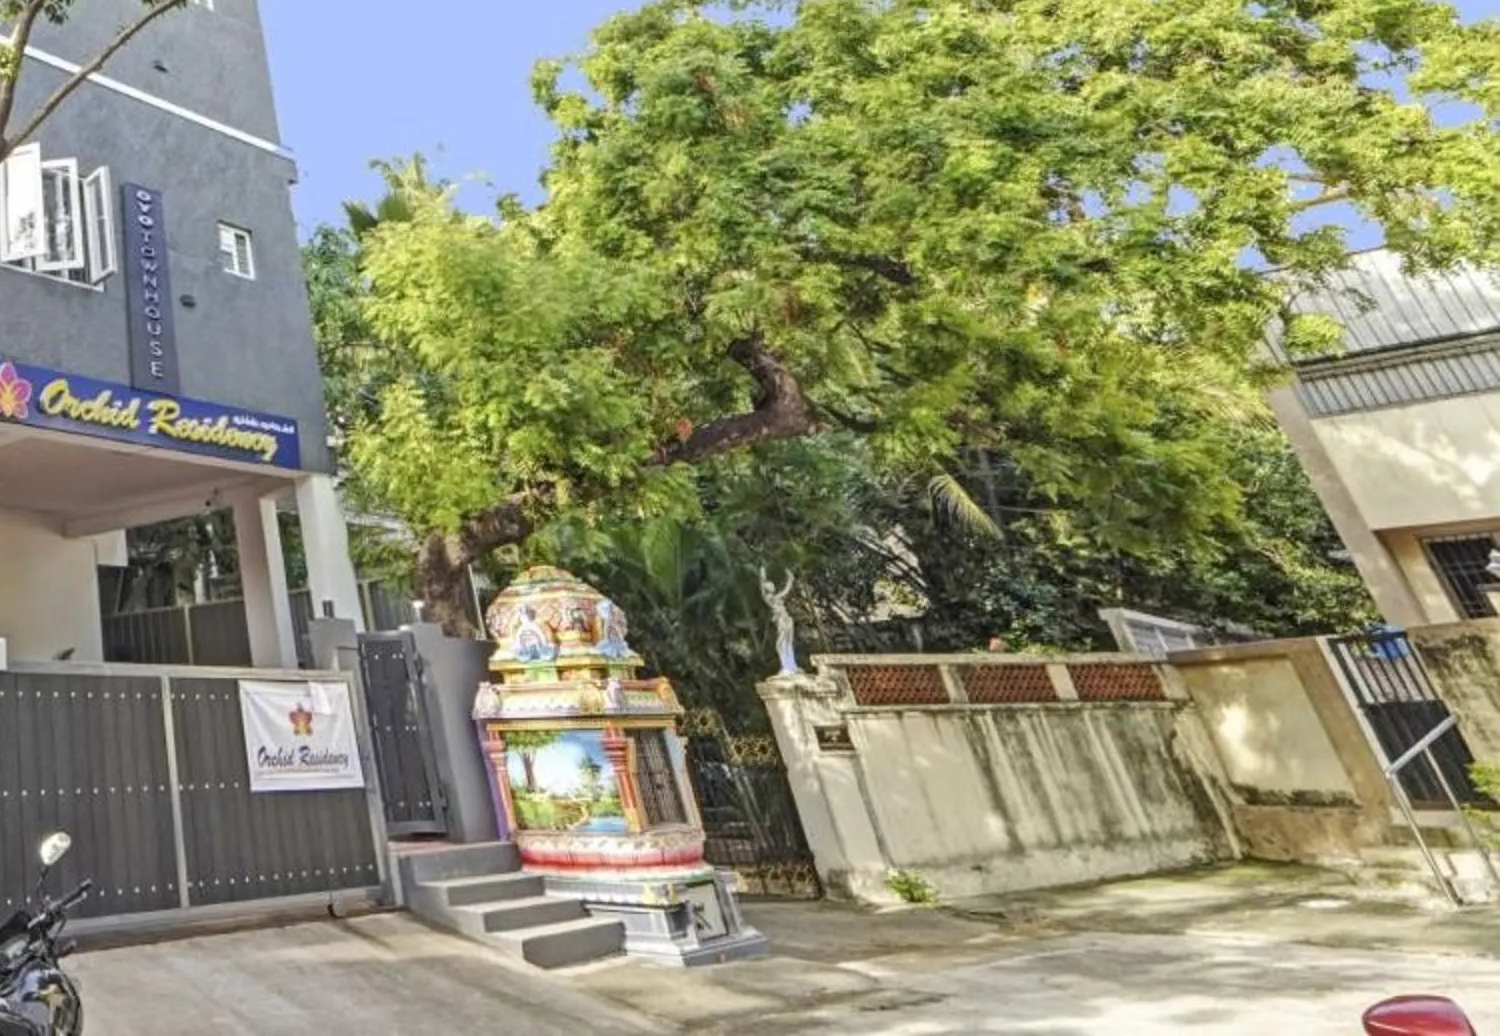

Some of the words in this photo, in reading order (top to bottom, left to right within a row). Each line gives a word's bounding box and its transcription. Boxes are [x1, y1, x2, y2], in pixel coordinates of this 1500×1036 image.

[39, 378, 140, 430] Orchid
[147, 399, 277, 461] Residency
[257, 745, 294, 768] Orchid
